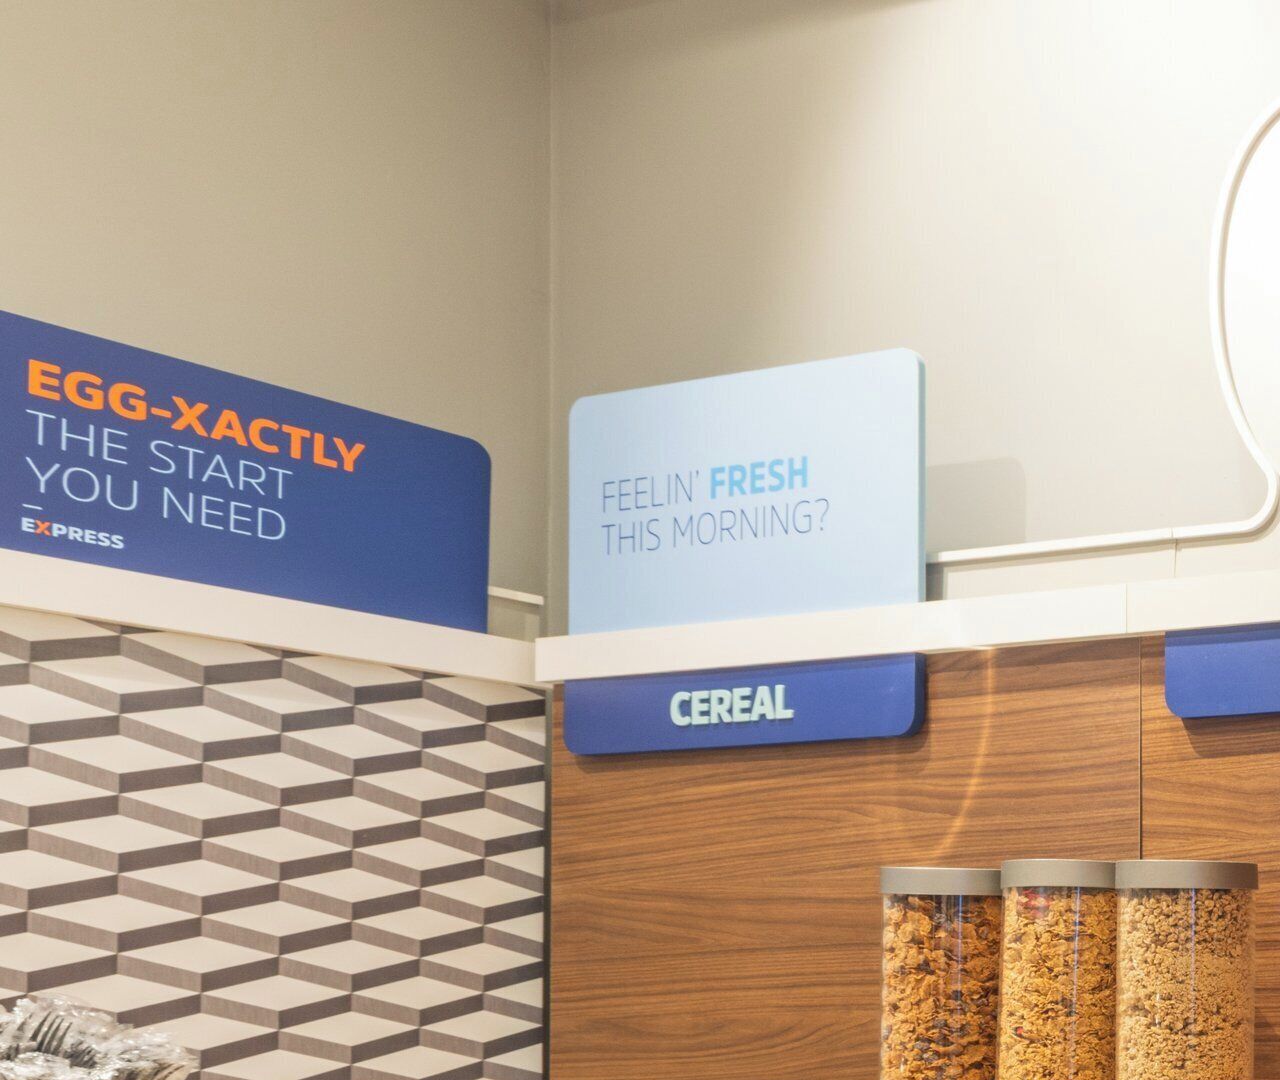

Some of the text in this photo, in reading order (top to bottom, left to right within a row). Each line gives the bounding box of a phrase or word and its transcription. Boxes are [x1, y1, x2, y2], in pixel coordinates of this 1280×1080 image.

[27, 358, 366, 473] EGG-XACTLY
[26, 409, 294, 500] THE START
[709, 456, 809, 499] FRESH
[25, 455, 287, 541] YOU NEED
[602, 497, 830, 555] THIS MORNING?
[21, 516, 125, 550] EXPRESS
[669, 684, 795, 727] CEREAL
